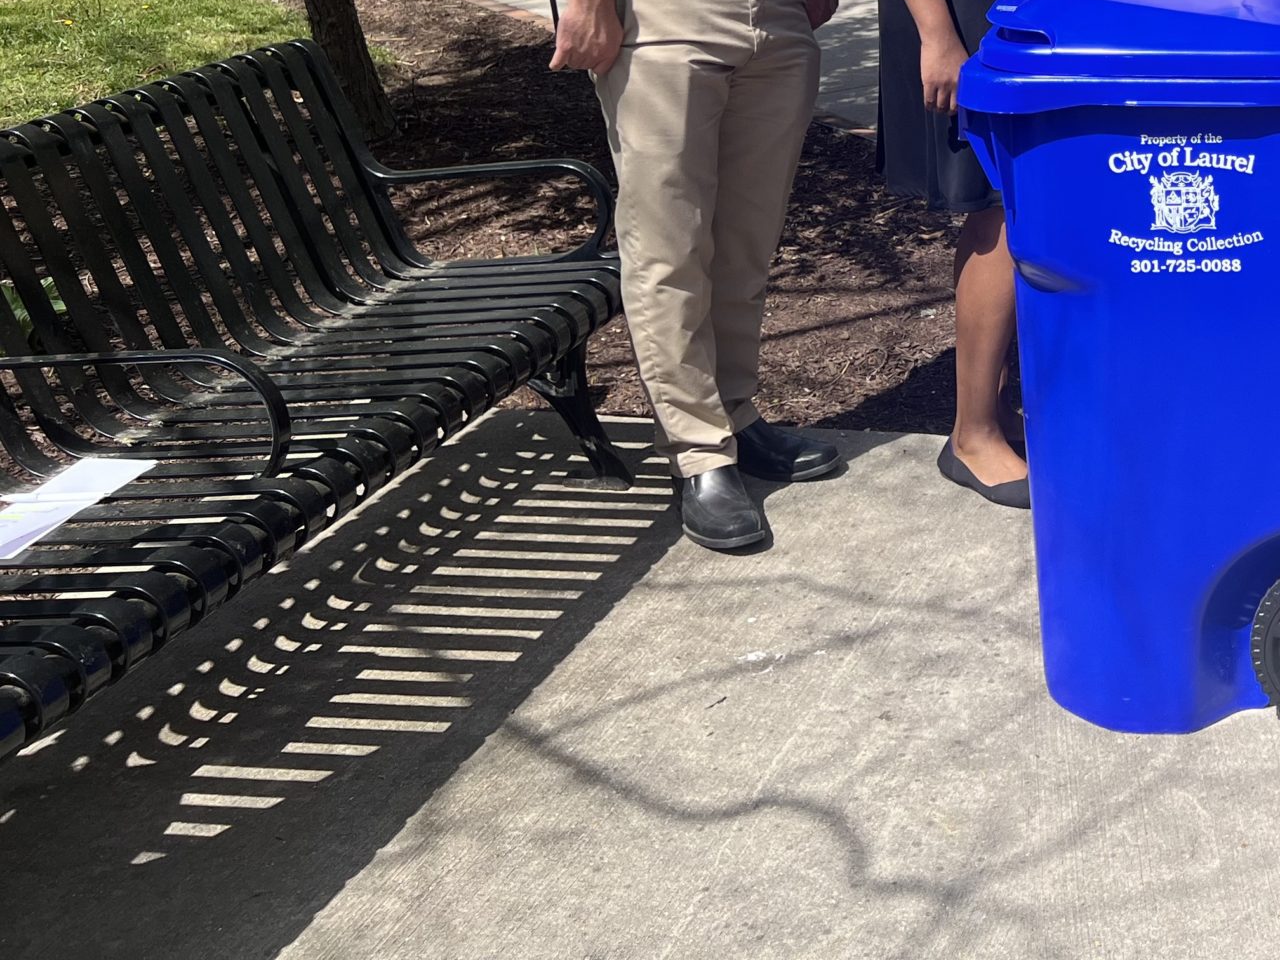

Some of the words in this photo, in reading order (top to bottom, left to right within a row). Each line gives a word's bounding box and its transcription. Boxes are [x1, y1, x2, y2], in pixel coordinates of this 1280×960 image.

[1140, 134, 1187, 147] Property
[1190, 133, 1202, 144] of
[1204, 133, 1222, 144] the
[1108, 151, 1153, 175] City
[1157, 147, 1180, 166] of
[1184, 147, 1255, 174] Laurel
[1109, 229, 1183, 255] Recycling
[1187, 231, 1264, 252] Collection
[1131, 259, 1242, 273] 301-725-0088
